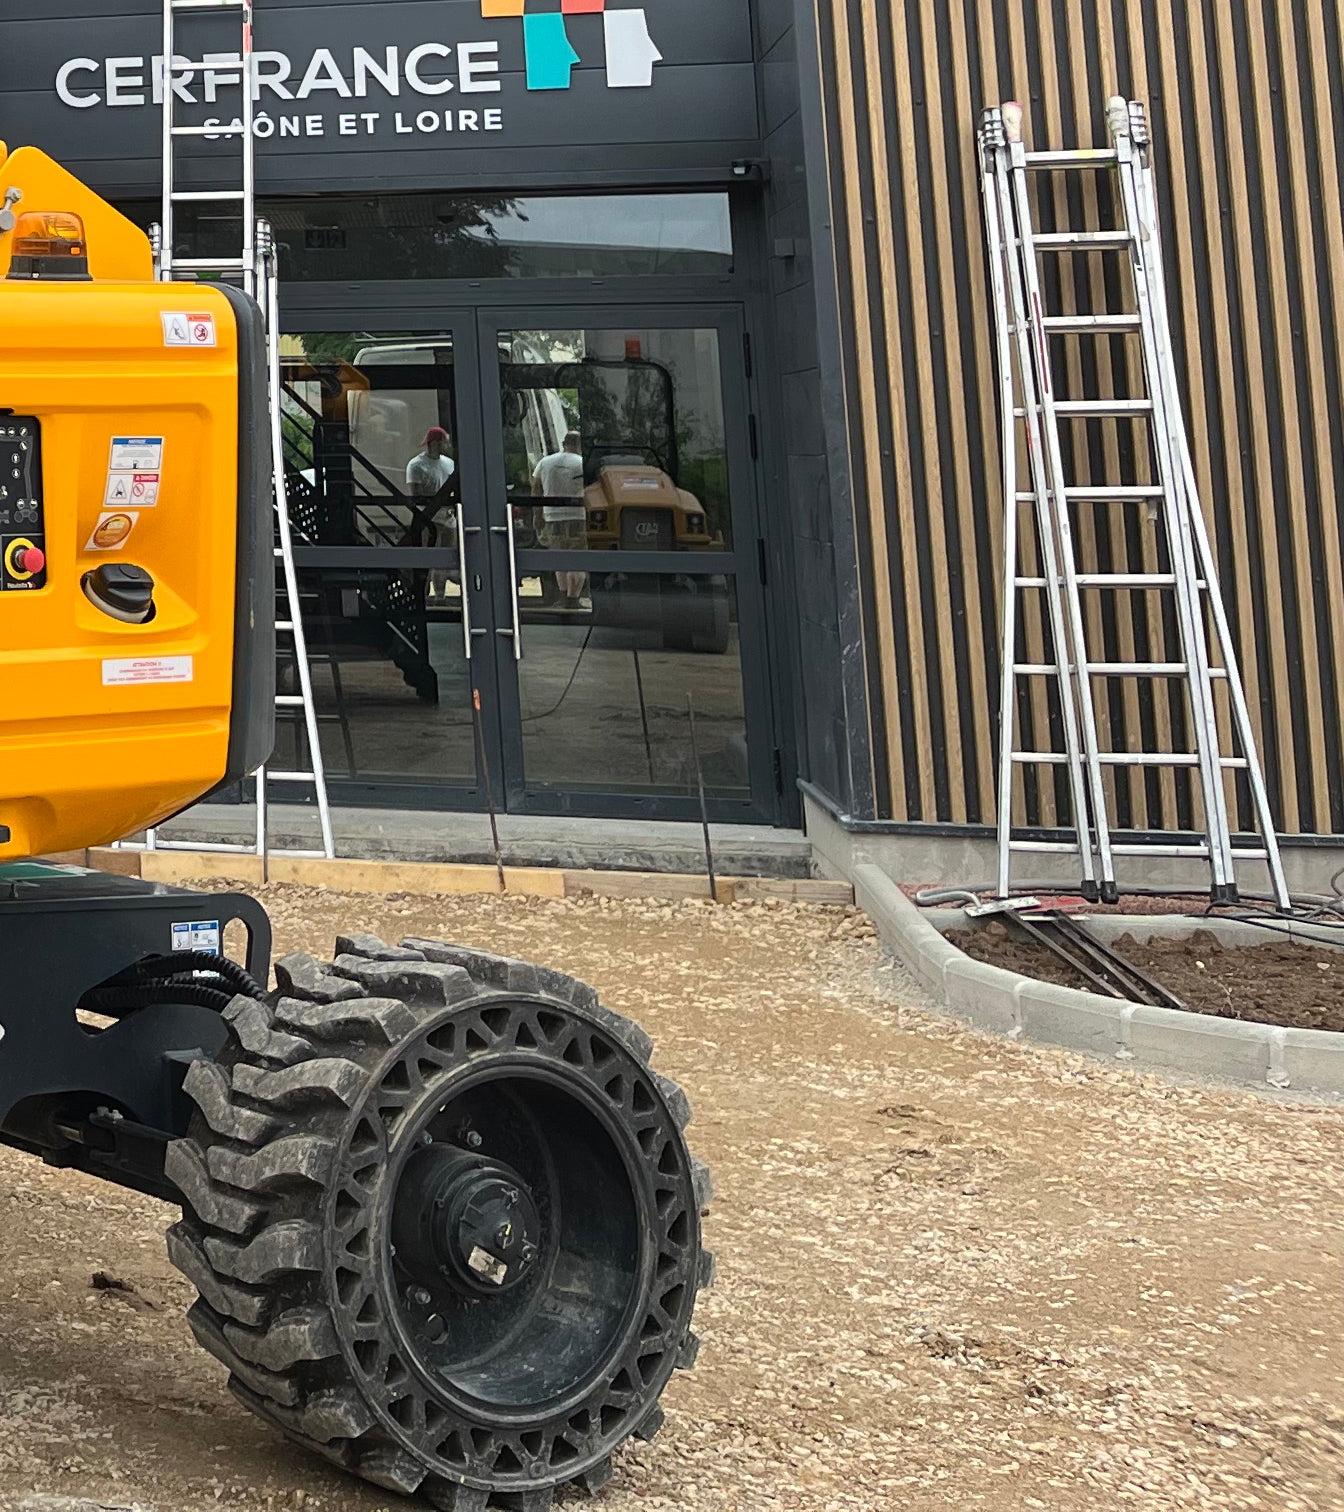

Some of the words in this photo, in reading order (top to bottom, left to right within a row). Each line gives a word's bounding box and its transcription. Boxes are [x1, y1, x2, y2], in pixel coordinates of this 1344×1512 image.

[55, 41, 501, 108] CERFRANCE
[339, 112, 380, 135] ET
[395, 108, 503, 133] LOIRE
